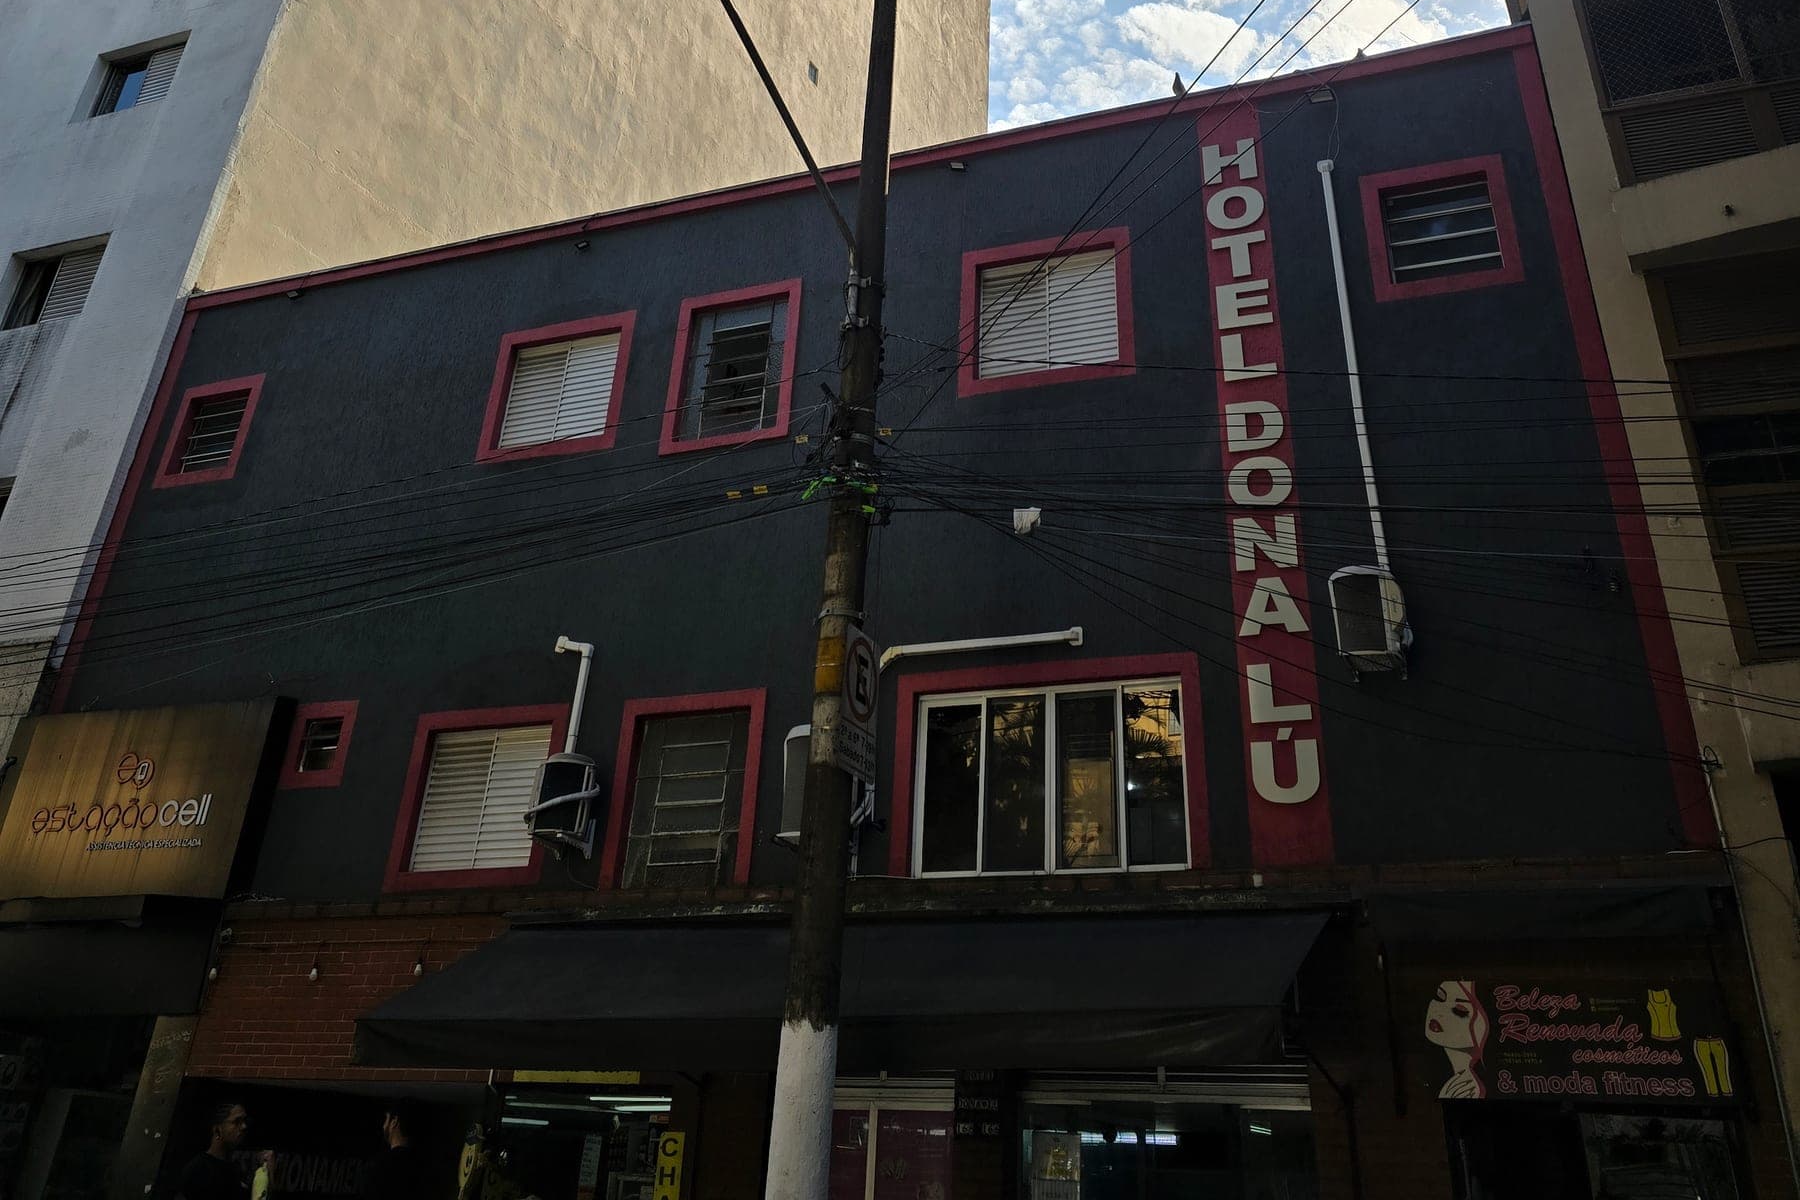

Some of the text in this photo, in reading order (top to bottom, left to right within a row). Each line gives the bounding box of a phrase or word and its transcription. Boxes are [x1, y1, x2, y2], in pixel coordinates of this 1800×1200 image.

[1201, 137, 1278, 383] HOTEL
[1493, 984, 1582, 1018] Beleza
[1498, 1014, 1644, 1044] Renovada
[1572, 1042, 1683, 1065] cosméticos
[1497, 1070, 1696, 1097] & moda fitness
